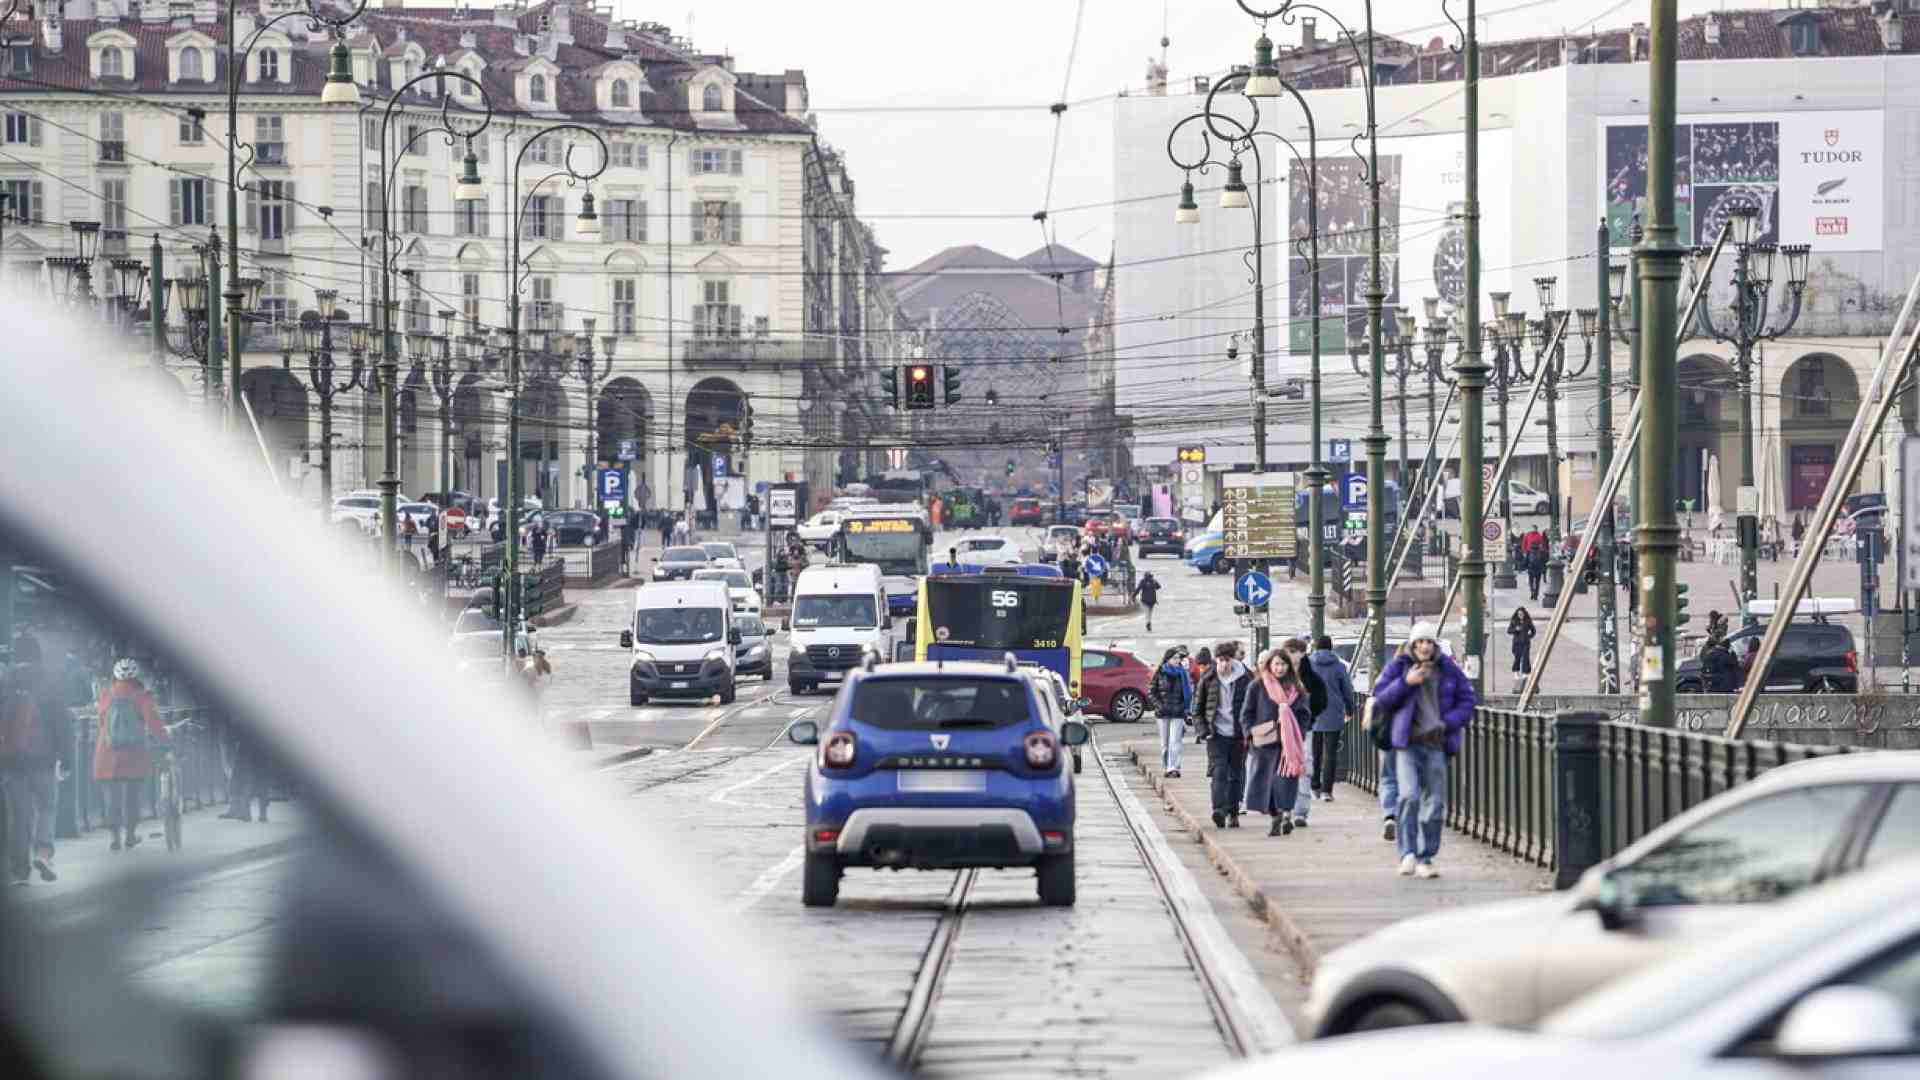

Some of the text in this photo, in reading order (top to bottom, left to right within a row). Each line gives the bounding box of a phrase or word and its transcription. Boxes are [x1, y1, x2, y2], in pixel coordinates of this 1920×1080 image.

[1800, 151, 1863, 163] TUDOR
[1335, 443, 1347, 456] P
[604, 476, 620, 494] P
[1349, 482, 1367, 504] P
[991, 590, 1018, 607] 56
[1033, 639, 1057, 648] 3410
